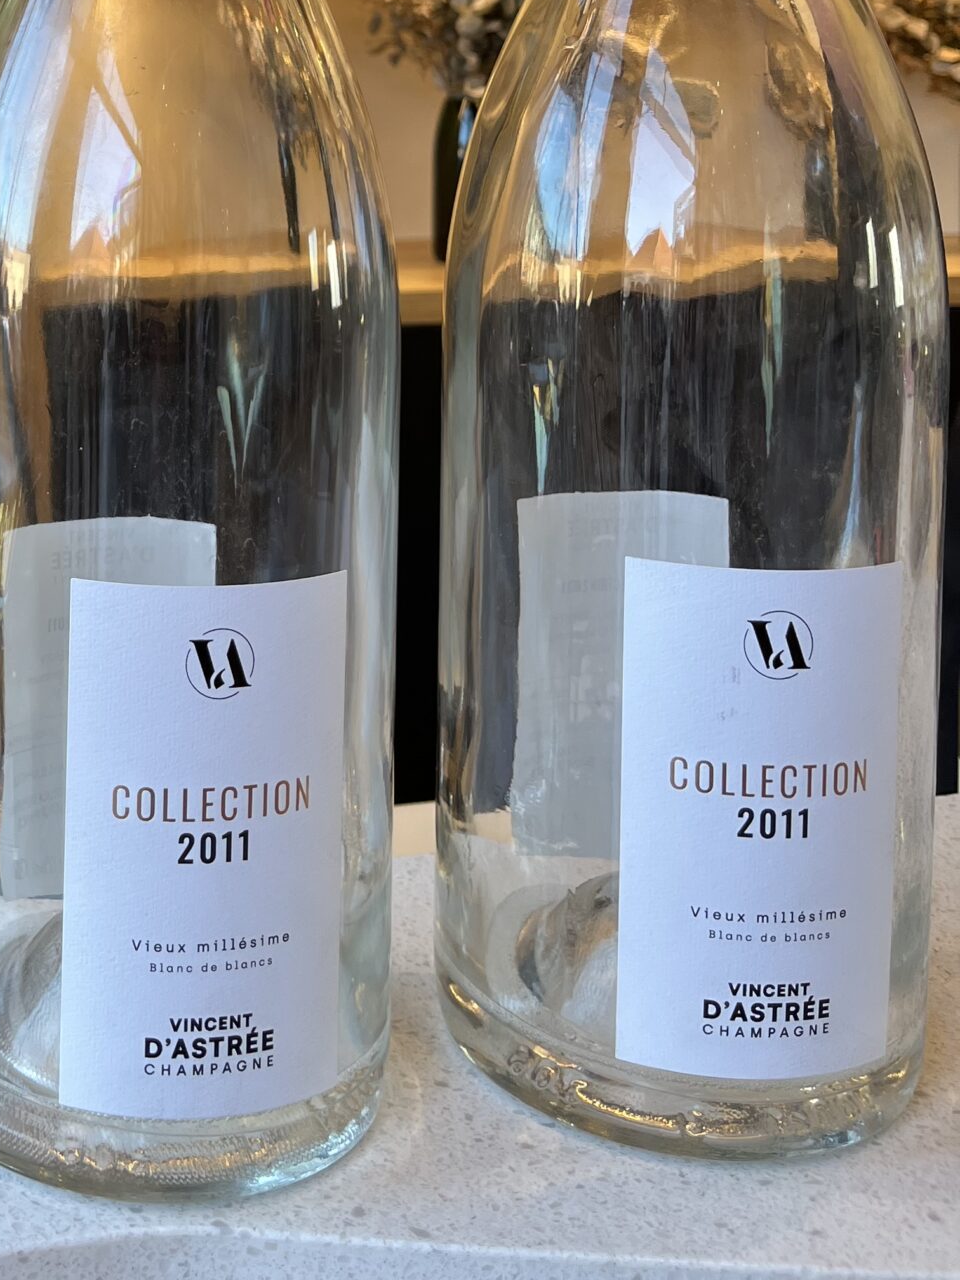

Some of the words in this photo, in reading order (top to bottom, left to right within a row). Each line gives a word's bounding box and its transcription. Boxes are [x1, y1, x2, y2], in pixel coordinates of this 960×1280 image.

[669, 756, 868, 799] COLLECTION
[111, 775, 311, 824] COLLECTION
[736, 808, 810, 840] 2011
[177, 829, 251, 865] 2011
[690, 906, 745, 922] Vieux
[756, 908, 848, 925] millésime
[131, 938, 187, 954] Vieux
[196, 932, 291, 953] millésime
[708, 929, 753, 943] Blanc
[760, 932, 777, 943] de
[784, 930, 831, 942] blancs
[149, 962, 193, 973] Blanc
[201, 962, 218, 973] de
[225, 957, 273, 971] blancs
[728, 982, 810, 999] VINCENT
[702, 995, 831, 1021] D'ASTRÉE
[169, 1013, 253, 1033] VINCENT
[702, 1022, 830, 1039] CHAMPAGNE
[144, 1027, 275, 1059] D'ASTRÉE
[144, 1054, 275, 1076] CHAMPAGNE
